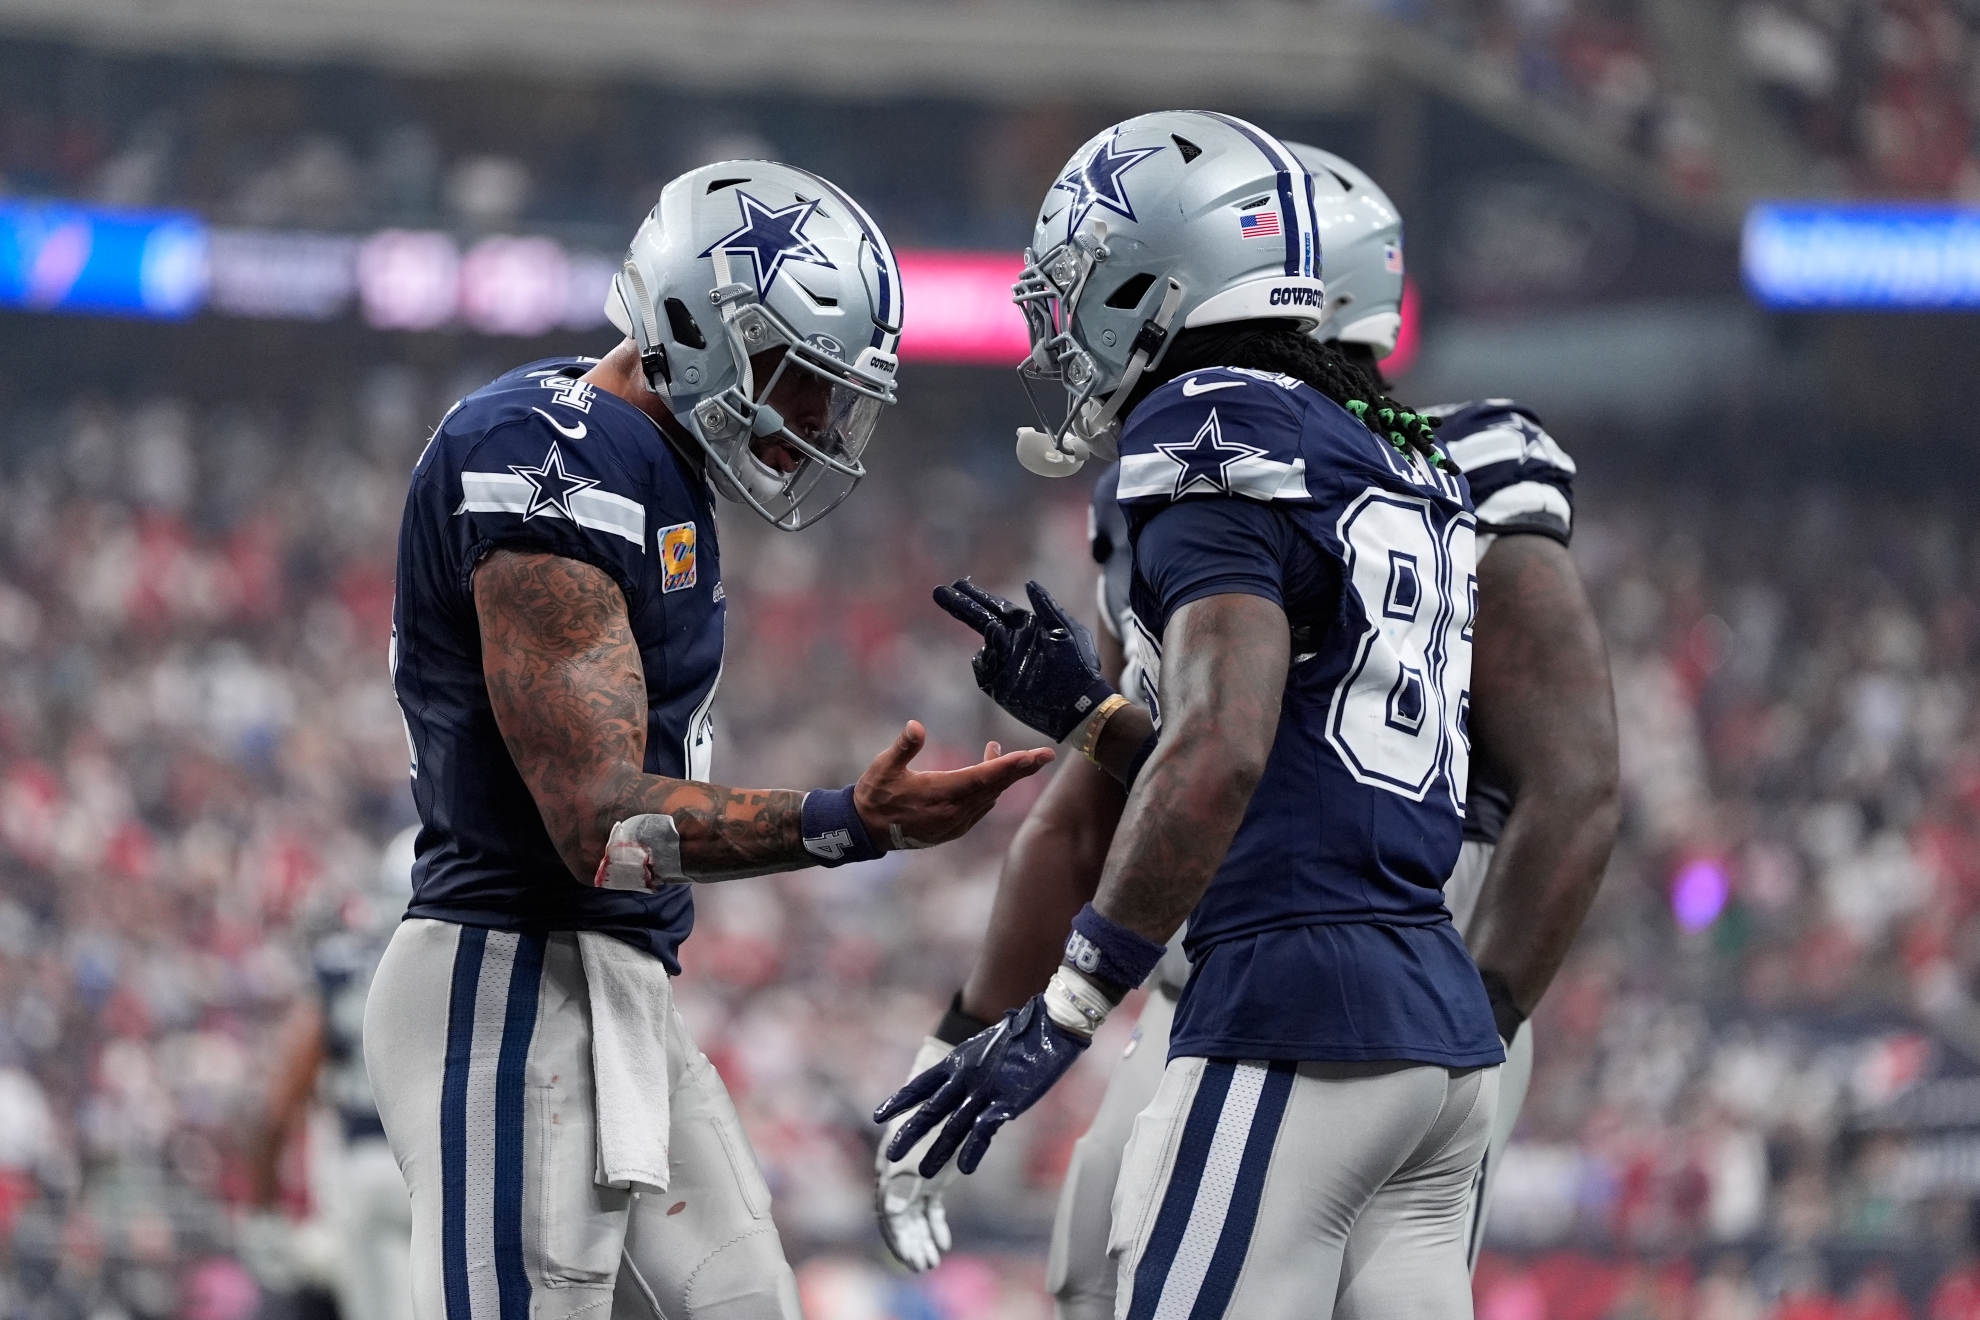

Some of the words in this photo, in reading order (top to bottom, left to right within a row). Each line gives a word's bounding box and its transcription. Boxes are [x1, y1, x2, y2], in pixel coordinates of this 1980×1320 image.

[1269, 287, 1324, 310] COWBOY
[540, 376, 597, 414] 4
[664, 528, 694, 575] C
[1325, 487, 1478, 819] 88
[1074, 695, 1093, 713] 88
[803, 828, 854, 860] 4
[1065, 929, 1102, 973] 88
